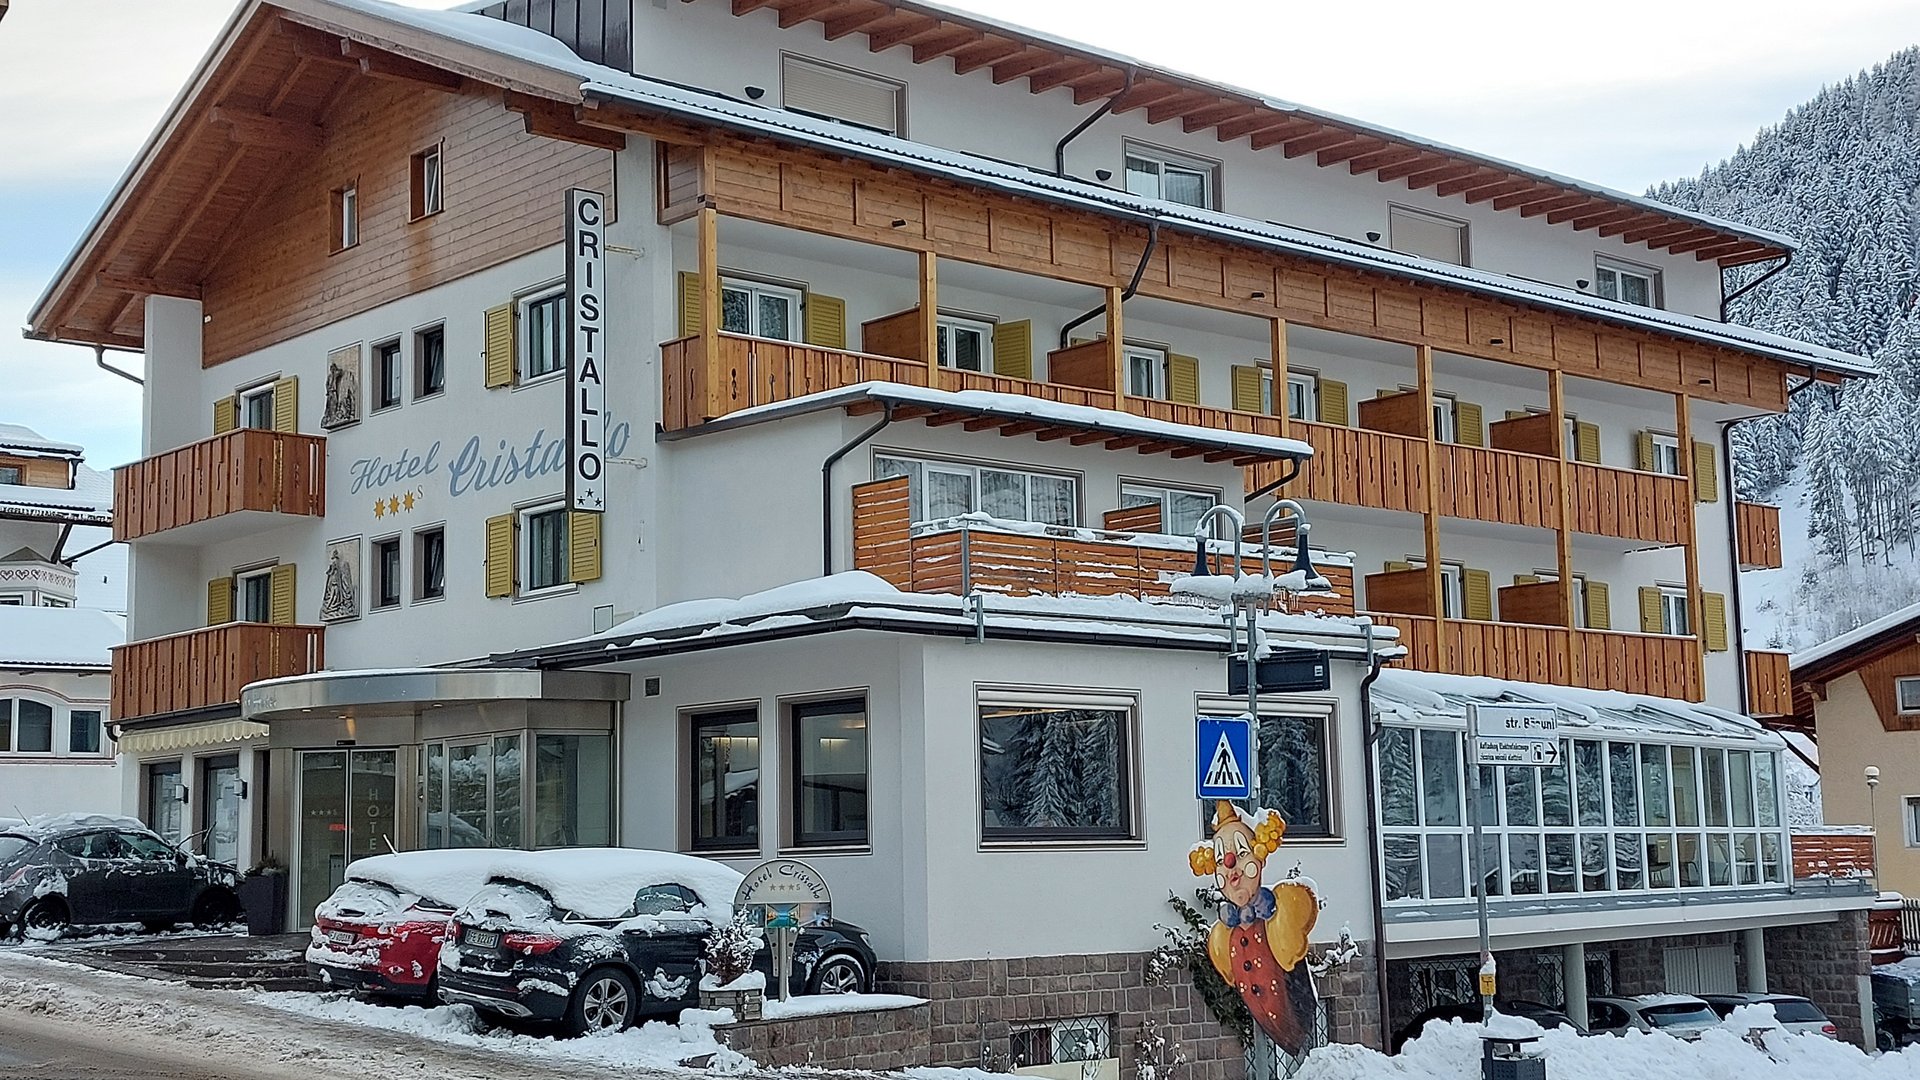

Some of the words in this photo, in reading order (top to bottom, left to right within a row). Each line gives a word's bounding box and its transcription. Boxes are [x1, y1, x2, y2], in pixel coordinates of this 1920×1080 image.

[578, 198, 601, 481] CRISTALLO
[351, 441, 441, 495] Hotel
[448, 411, 630, 497] Cristao
[1505, 716, 1521, 729] str.
[367, 788, 380, 850] HOTE
[741, 866, 773, 900] Hotel
